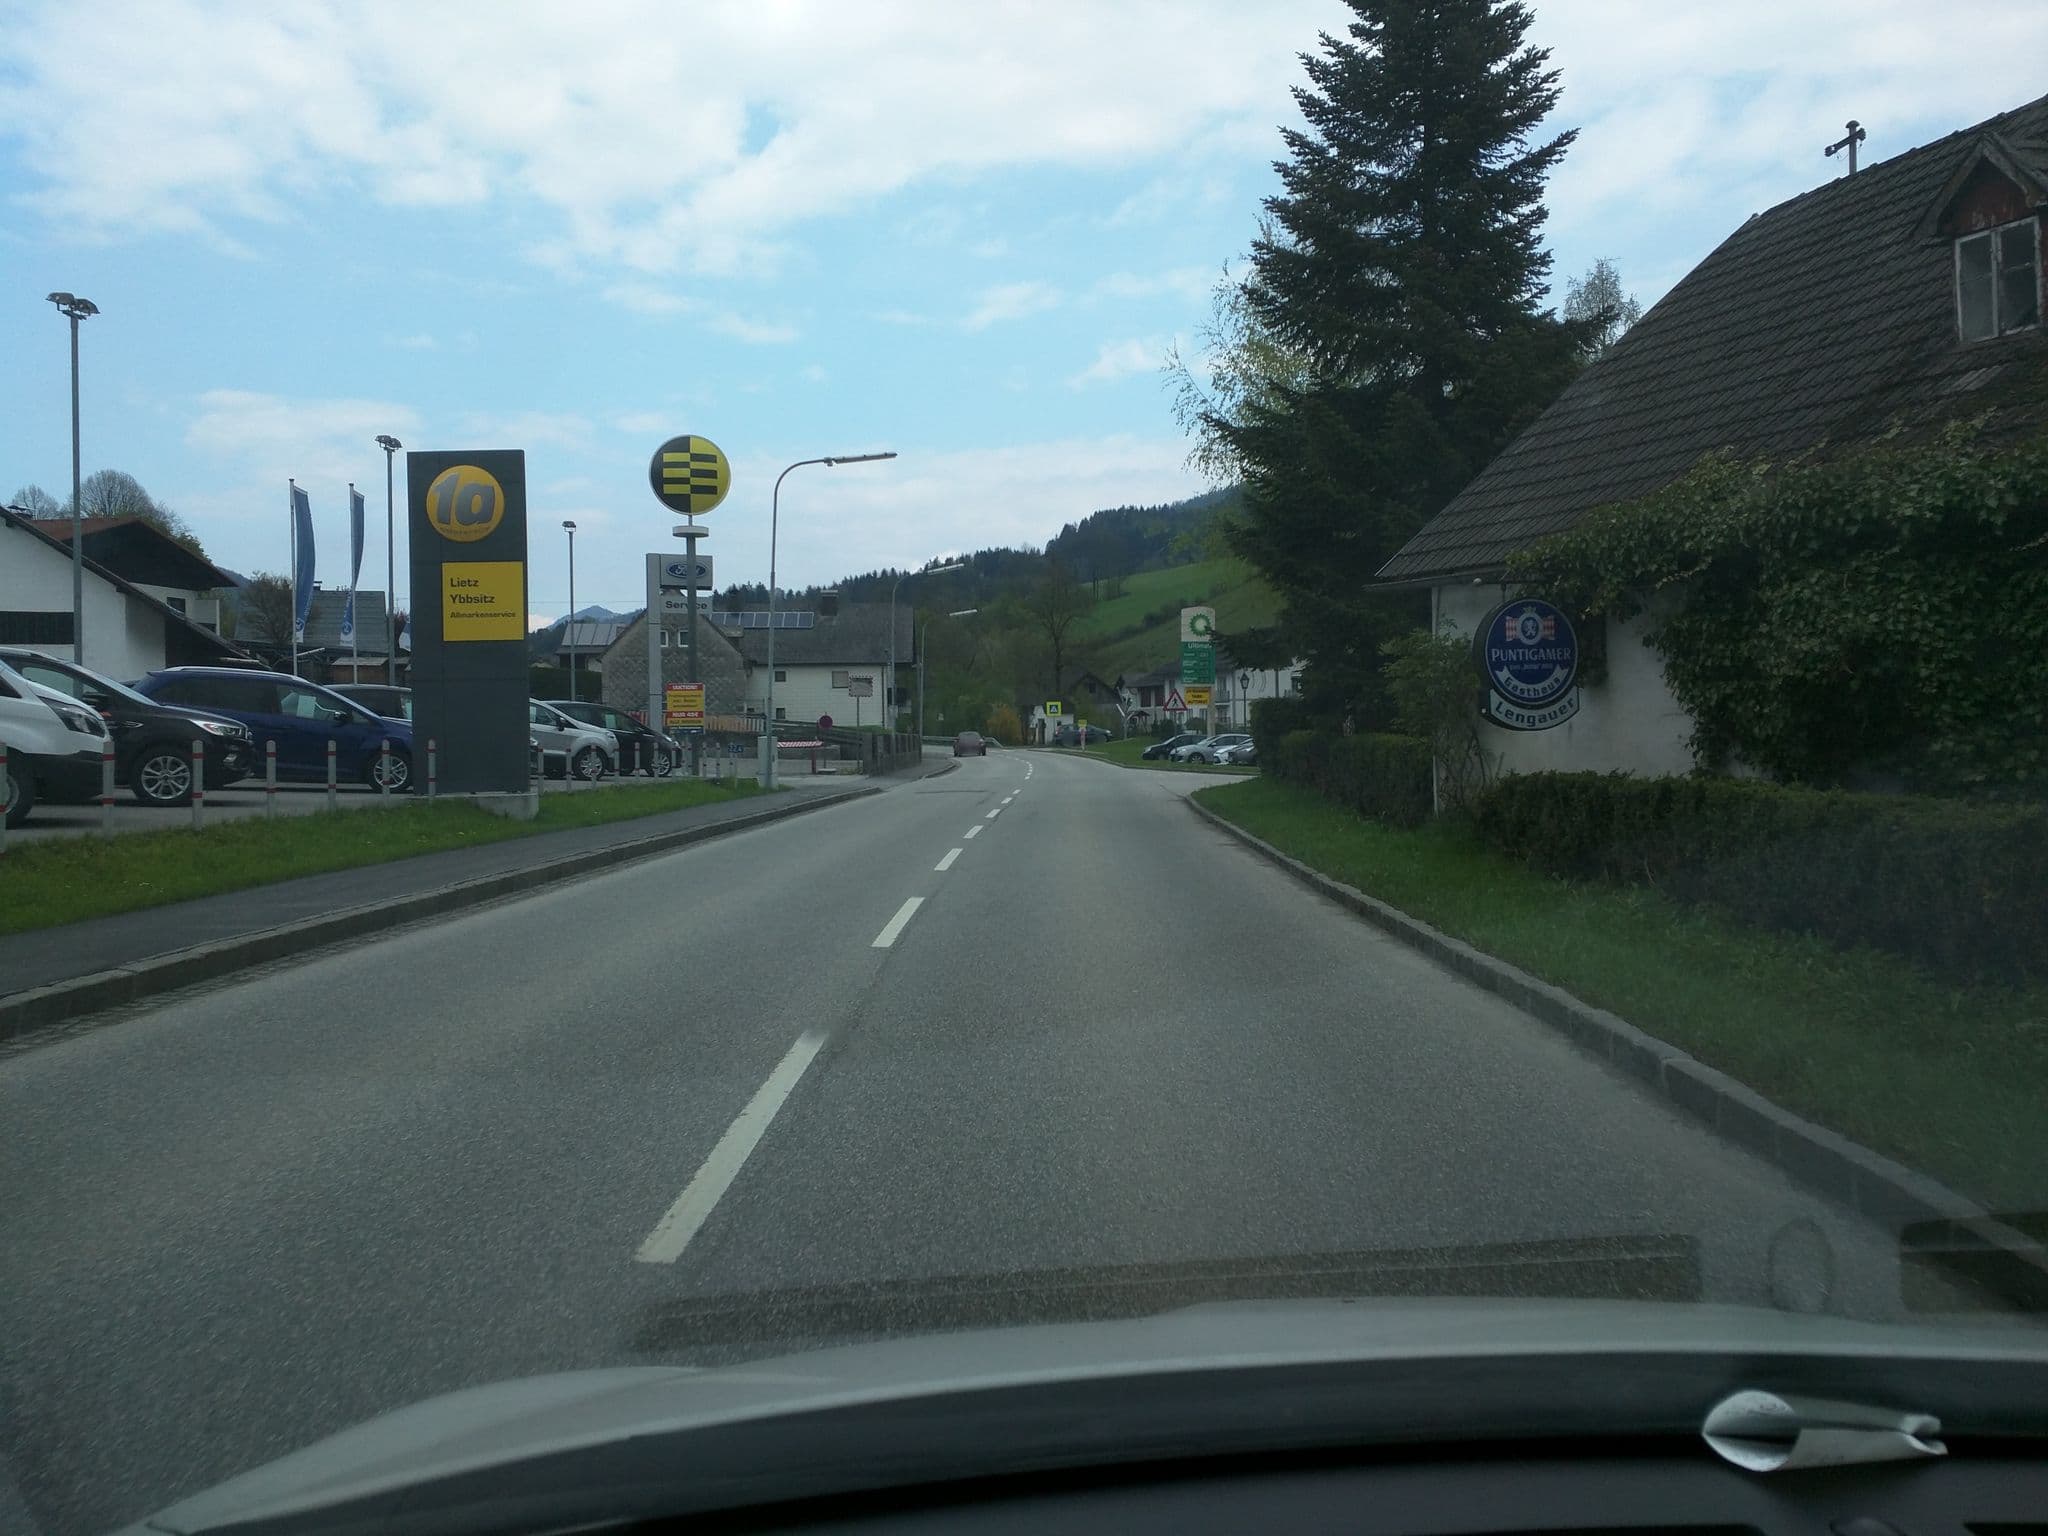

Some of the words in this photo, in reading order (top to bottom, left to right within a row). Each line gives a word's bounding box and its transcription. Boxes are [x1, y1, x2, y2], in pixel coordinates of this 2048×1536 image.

[450, 577, 480, 588] Lietz
[450, 593, 496, 604] Ybbsitz
[665, 600, 708, 610] Servce
[449, 610, 516, 619] Allmarkenservice
[1491, 648, 1572, 662] PUNTIGAMER
[1503, 676, 1561, 697] Gasthaus
[1495, 696, 1575, 728] Lengauer
